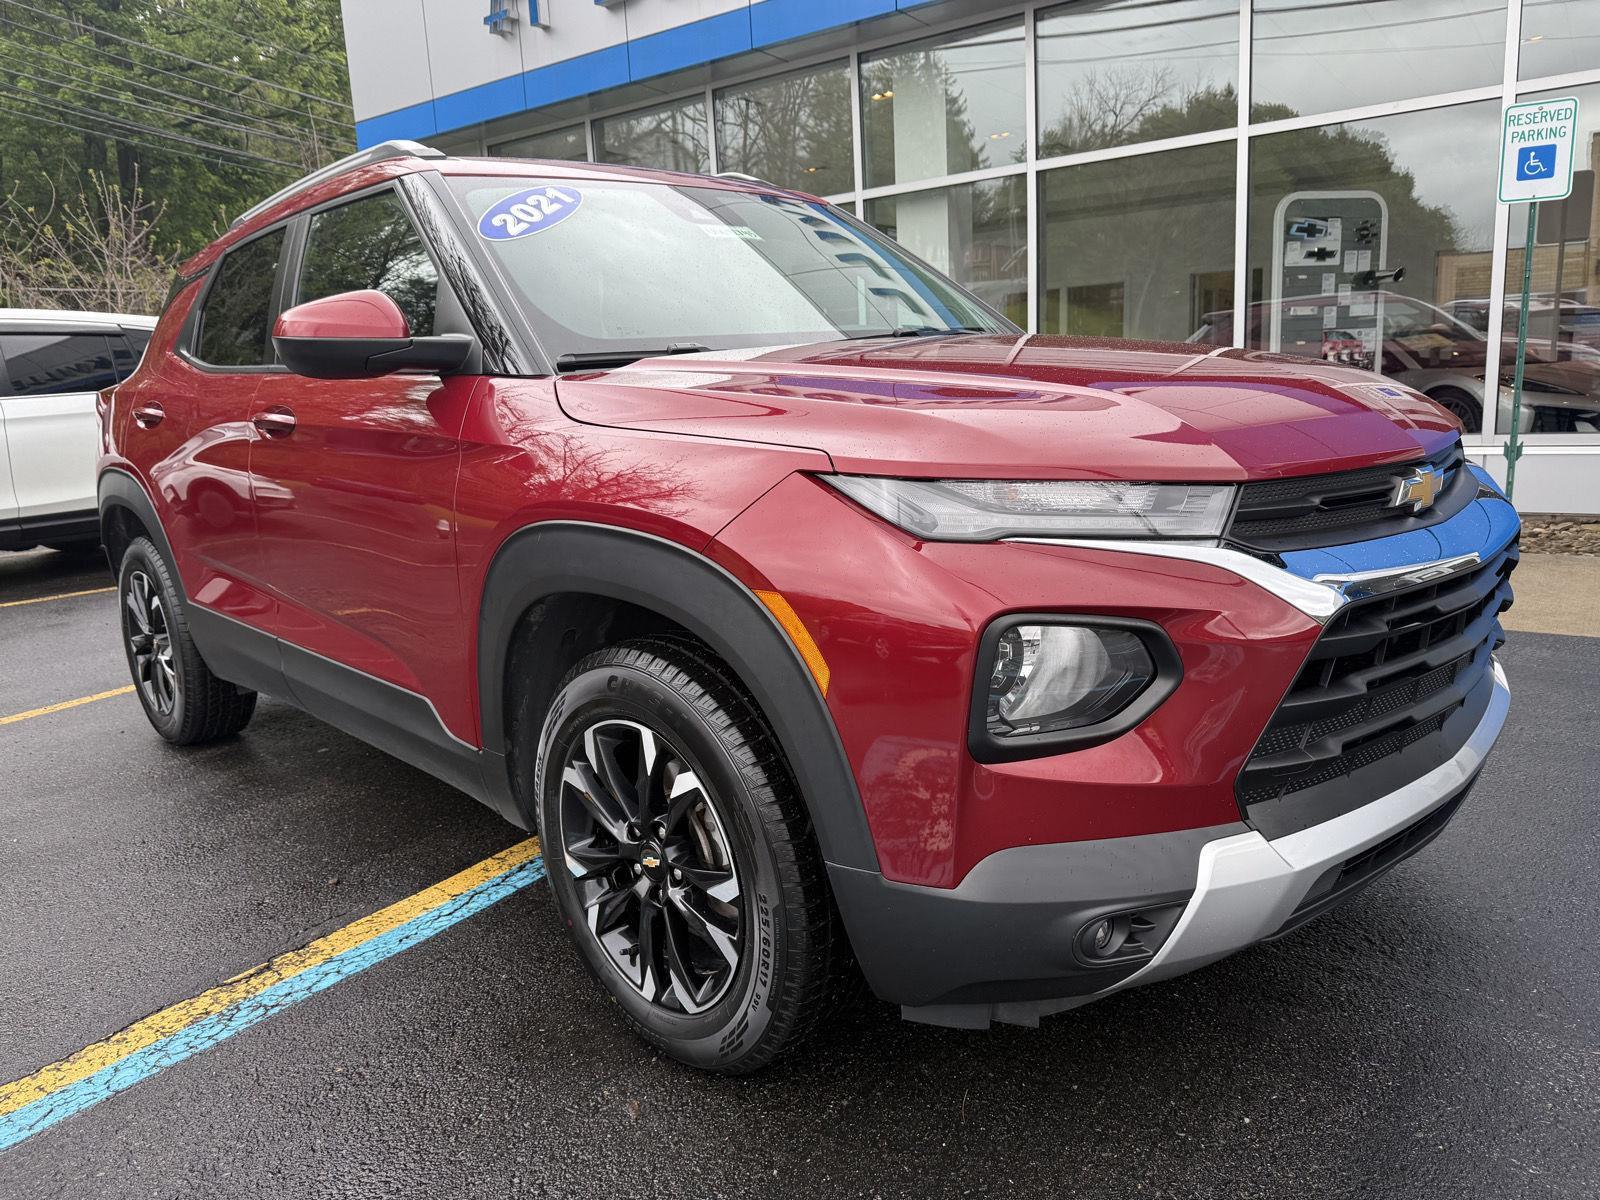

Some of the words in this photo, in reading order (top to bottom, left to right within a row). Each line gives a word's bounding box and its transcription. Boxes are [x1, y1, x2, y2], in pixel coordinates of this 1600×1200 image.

[1508, 107, 1573, 127] RESERVED
[1511, 126, 1567, 143] PARKING
[491, 187, 575, 236] 2021
[758, 893, 771, 988] 225/60R17
[751, 993, 762, 1012] 99V
